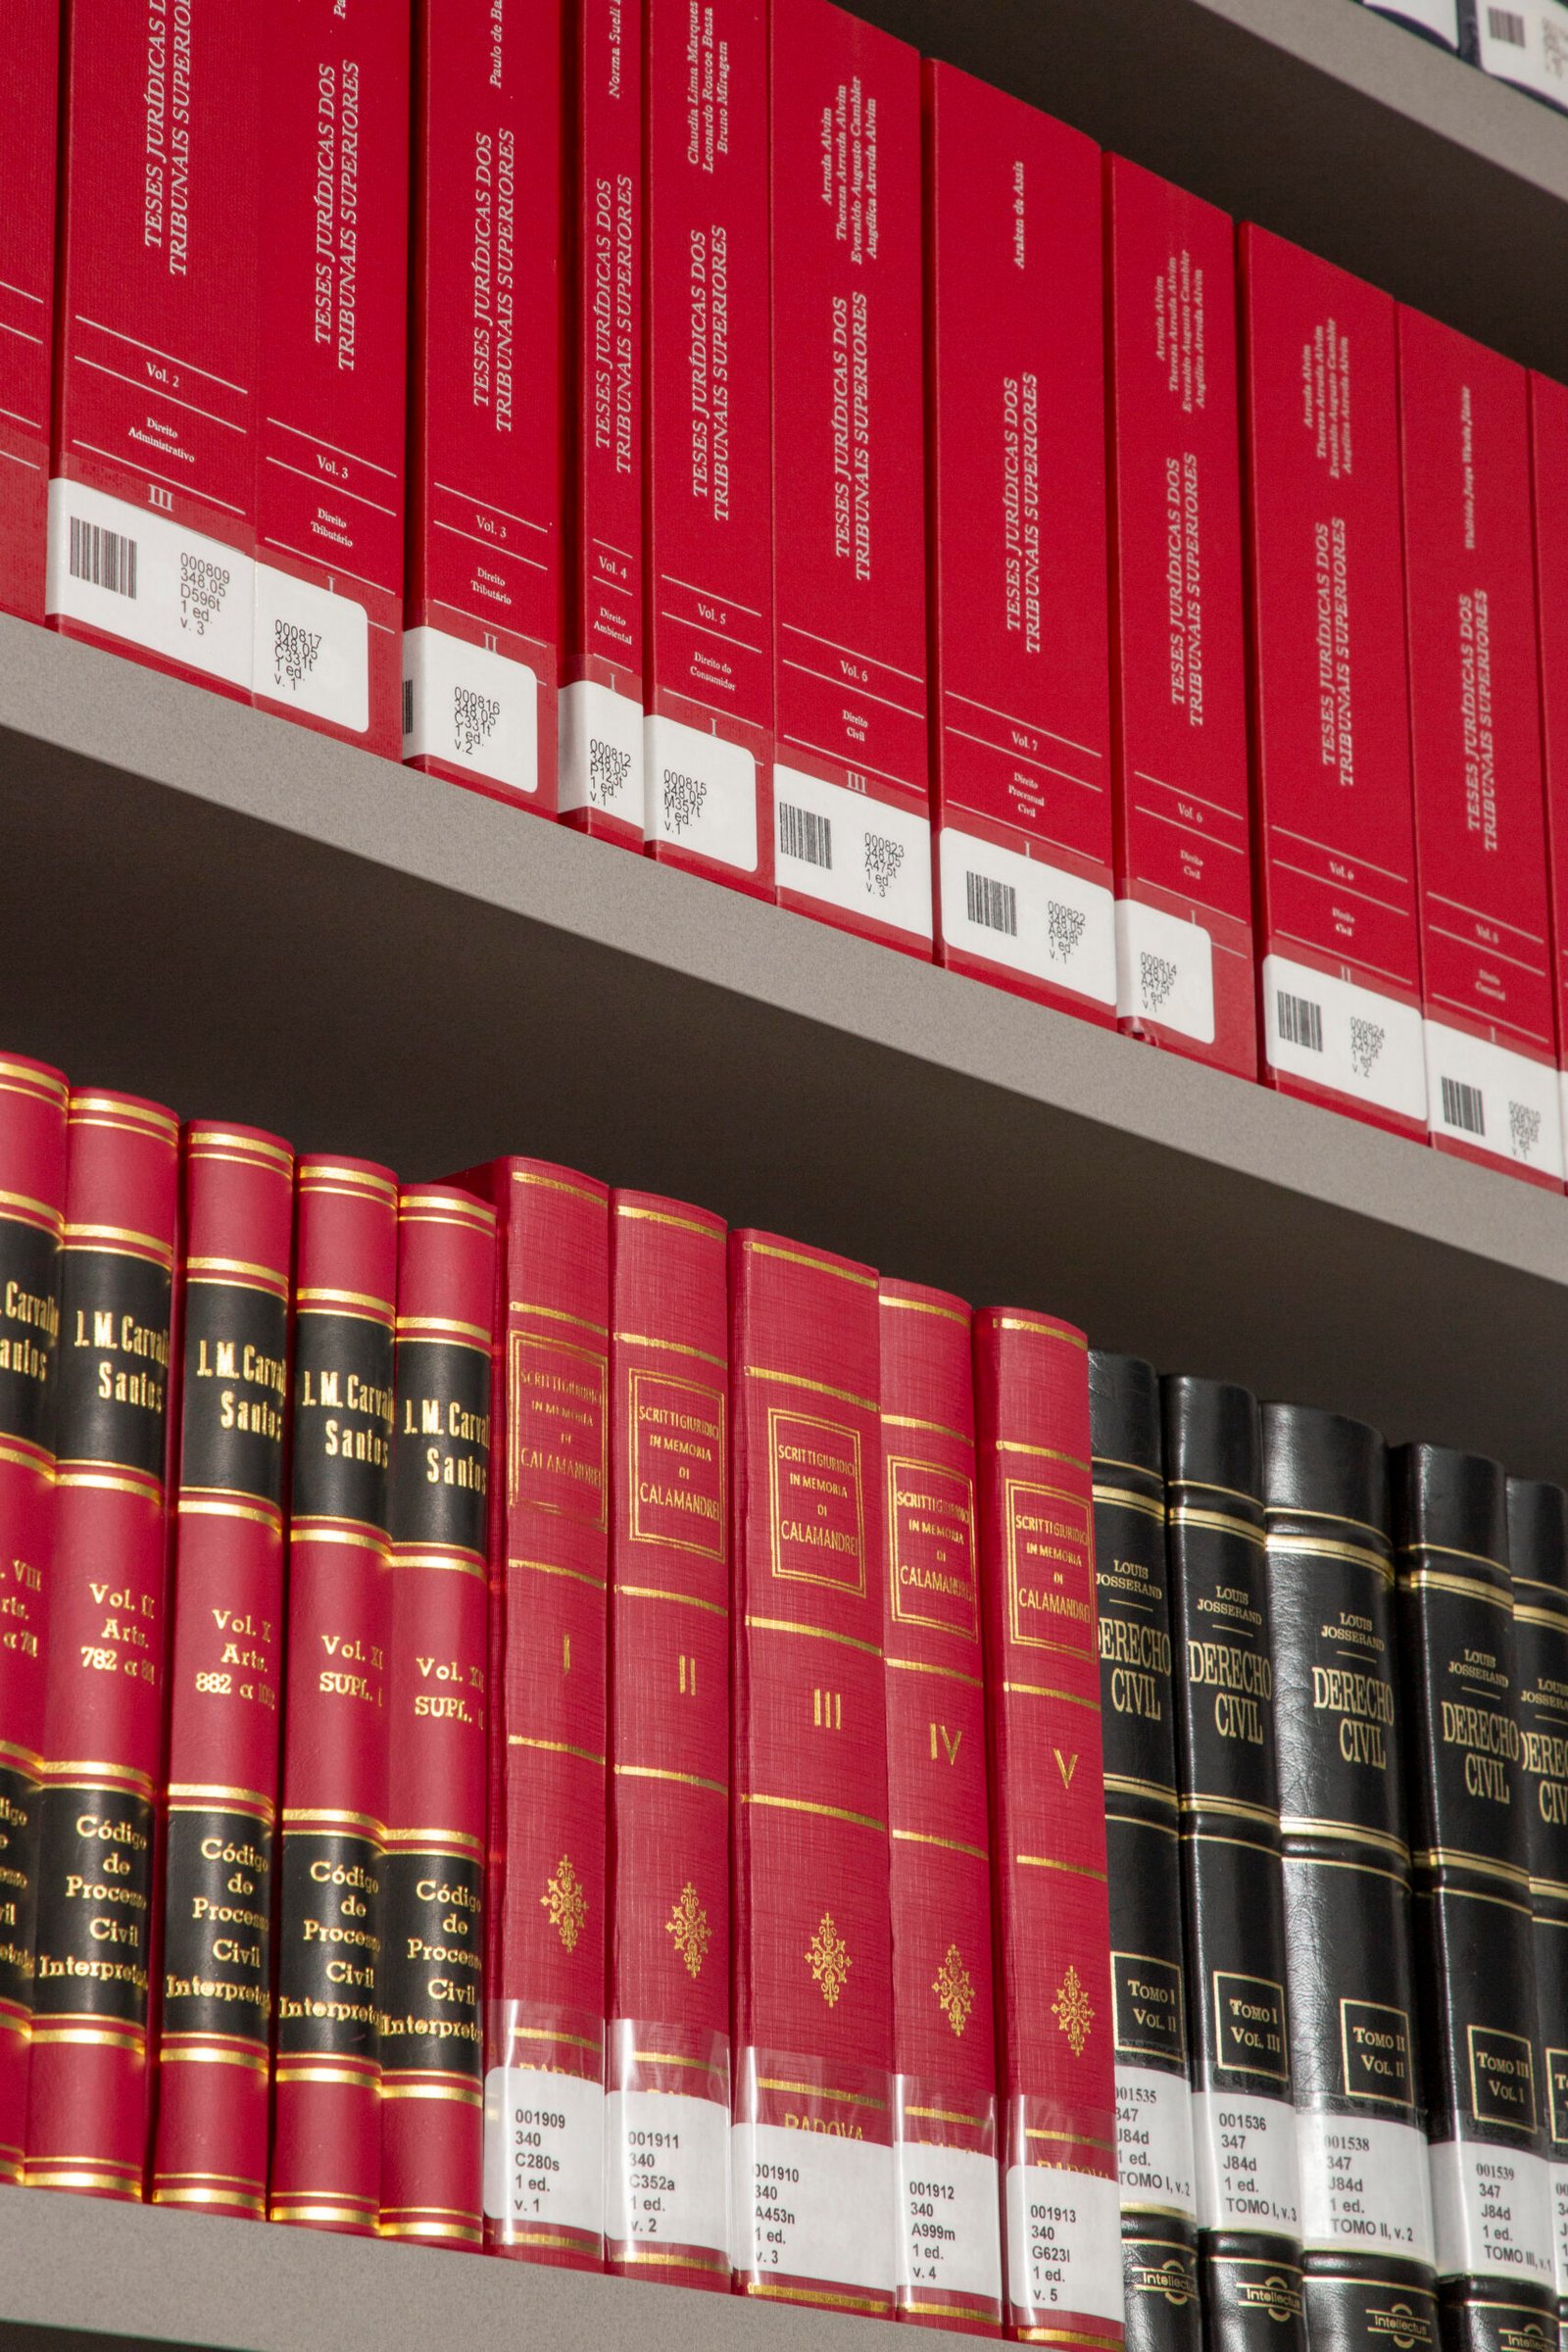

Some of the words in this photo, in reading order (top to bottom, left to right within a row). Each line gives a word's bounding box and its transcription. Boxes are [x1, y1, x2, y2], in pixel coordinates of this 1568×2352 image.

[490, 24, 503, 42] de
[609, 7, 621, 44] Sueli
[688, 1, 701, 65] Marques
[702, 8, 713, 48] Bessa
[489, 45, 503, 88] Paulo
[609, 47, 621, 99] Norma
[702, 52, 713, 101] Roscoe
[717, 41, 730, 106] Miragem
[143, 18, 168, 163] JURÍDICAS
[318, 64, 335, 120] DOS
[688, 68, 699, 105] Lima
[835, 85, 847, 129] Alvim
[340, 60, 359, 223] SUPERIORES
[688, 109, 699, 165] Claudia
[702, 105, 713, 173] Leonardo
[717, 109, 729, 154] Bruno
[820, 108, 832, 152] Alvim
[475, 131, 492, 186] DOS
[835, 132, 847, 182] Arruda
[314, 122, 336, 262] JURÍDICAS
[820, 154, 832, 205] Arruda
[1012, 161, 1024, 196] Assis
[144, 163, 166, 248] TESES
[170, 130, 190, 276] TRIBUNAIS
[497, 128, 514, 289] SUPERIORES
[596, 178, 612, 231] DOS
[835, 185, 847, 241] Thereza
[472, 190, 493, 326] JURÍDICAS
[616, 174, 633, 332] SUPERIORES
[690, 230, 706, 282] DOS
[315, 262, 333, 345] TESES
[338, 228, 356, 370] TRIBUNAIS
[593, 235, 613, 368] JURÍDICAS
[711, 224, 727, 381] SUPERIORES
[833, 297, 848, 347] DOS
[473, 327, 490, 407] TESES
[496, 292, 513, 432] TRIBUNAIS
[688, 287, 710, 419] JURÍDICAS
[852, 292, 868, 444] SUPERIORES
[146, 362, 169, 385] Vol.
[172, 374, 179, 387] 2
[596, 370, 612, 449] TESES
[616, 337, 632, 474] TRIBUNAIS
[832, 352, 853, 480] JURÍDICAS
[1004, 377, 1018, 426] DOS
[128, 426, 195, 464] Administrativo
[147, 417, 177, 438] Direito
[1023, 372, 1039, 520] SUPERIORES
[317, 455, 339, 476] Vol.
[340, 467, 349, 479] 3
[692, 421, 708, 497] TESES
[713, 385, 729, 521] TRIBUNAIS
[148, 484, 174, 513] III
[1003, 430, 1023, 556] JURÍDICAS
[1166, 458, 1182, 506] DOS
[318, 508, 347, 529] Direito
[475, 514, 498, 536] Vol.
[500, 526, 507, 539] 3
[835, 482, 851, 558] TESES
[855, 448, 870, 581] TRIBUNAIS
[1184, 453, 1200, 596] SUPERIORES
[311, 521, 354, 549] Tributário
[180, 552, 231, 584] 000809
[180, 568, 226, 599] 348.05
[477, 566, 506, 587] Direito
[599, 556, 618, 576] Vol.
[619, 567, 627, 580] 4
[1166, 510, 1185, 632] JURÍDICAS
[180, 584, 221, 612] D596t
[470, 580, 512, 607] Tributário
[1006, 559, 1021, 631] TESES
[1025, 524, 1041, 654] TRIBUNAIS
[180, 617, 193, 632] v.
[196, 620, 205, 636] 3
[192, 606, 214, 625] ed.
[600, 608, 626, 627] Direito
[697, 603, 717, 624] Vol.
[718, 612, 726, 625] 5
[594, 621, 633, 646] Ambiental
[694, 652, 720, 671] Direito
[721, 663, 732, 675] do
[840, 661, 859, 679] Vol.
[860, 669, 868, 683] 6
[1171, 634, 1185, 705] TESES
[1188, 600, 1203, 726] TRIBUNAIS
[842, 710, 868, 729] Direito
[846, 726, 865, 742] Civil
[1032, 740, 1039, 753] 7
[94, 1310, 118, 1349] M.
[122, 1315, 169, 1367] Carval
[98, 1361, 164, 1413] Santos
[426, 1447, 487, 1495] Santos
[790, 1472, 801, 1487] IN
[802, 1476, 848, 1499] MEMORIA
[816, 1504, 828, 1518] DI
[781, 1520, 858, 1556] CALAMANDREI
[89, 1583, 135, 1612] Vol.
[1197, 1598, 1262, 1626] JOSSERAND
[1215, 1585, 1250, 1606] LOUIS
[101, 1618, 149, 1648] Arts.
[212, 1609, 257, 1637] Vol.
[1321, 1624, 1385, 1652] JOSSERAND
[1340, 1612, 1373, 1632] LOUIS
[80, 1646, 118, 1671] 782
[220, 1642, 268, 1672] Arts.
[321, 1635, 366, 1662] Vol.
[196, 1672, 232, 1694] 882
[319, 1671, 373, 1701] SUPL.
[678, 1654, 696, 1696] II
[1188, 1640, 1272, 1701] DERECHO
[812, 1689, 842, 1731] III
[1312, 1666, 1395, 1727] DERECHO
[1215, 1692, 1263, 1745] CIVIL
[930, 1722, 963, 1765] IV
[1340, 1717, 1387, 1771] CIVIL
[1053, 1747, 1079, 1789] V
[75, 1815, 147, 1850] Código
[310, 1861, 379, 1894] Código
[89, 1917, 139, 1947] Civil
[325, 1960, 375, 1989] Civil
[1396, 2034, 1405, 2052] II
[1396, 2062, 1404, 2079] II
[515, 2109, 565, 2129] 001909
[1218, 2112, 1267, 2132] 001536
[515, 2131, 541, 2146] 340
[1221, 2135, 1246, 2150] 347
[515, 2152, 560, 2172] C280s
[1223, 2156, 1256, 2172] J84d
[1476, 2163, 1515, 2180] 001539
[515, 2174, 522, 2189] 1
[528, 2177, 550, 2192] ed.
[909, 2180, 955, 2200] 001912
[1225, 2177, 1231, 2191] 1
[1237, 2178, 1259, 2193] ed.
[1479, 2182, 1501, 2198] 347
[514, 2199, 527, 2211] v.
[533, 2199, 540, 2212] 1
[910, 2202, 934, 2218] 340
[1030, 2204, 1077, 2224] 001913
[1226, 2197, 1270, 2216] TOMO
[1291, 2207, 1298, 2222] 3
[1481, 2204, 1511, 2221] J84d
[911, 2223, 956, 2241] A999m
[1031, 2226, 1055, 2241] 340
[1374, 2313, 1429, 2336] Intellectus
